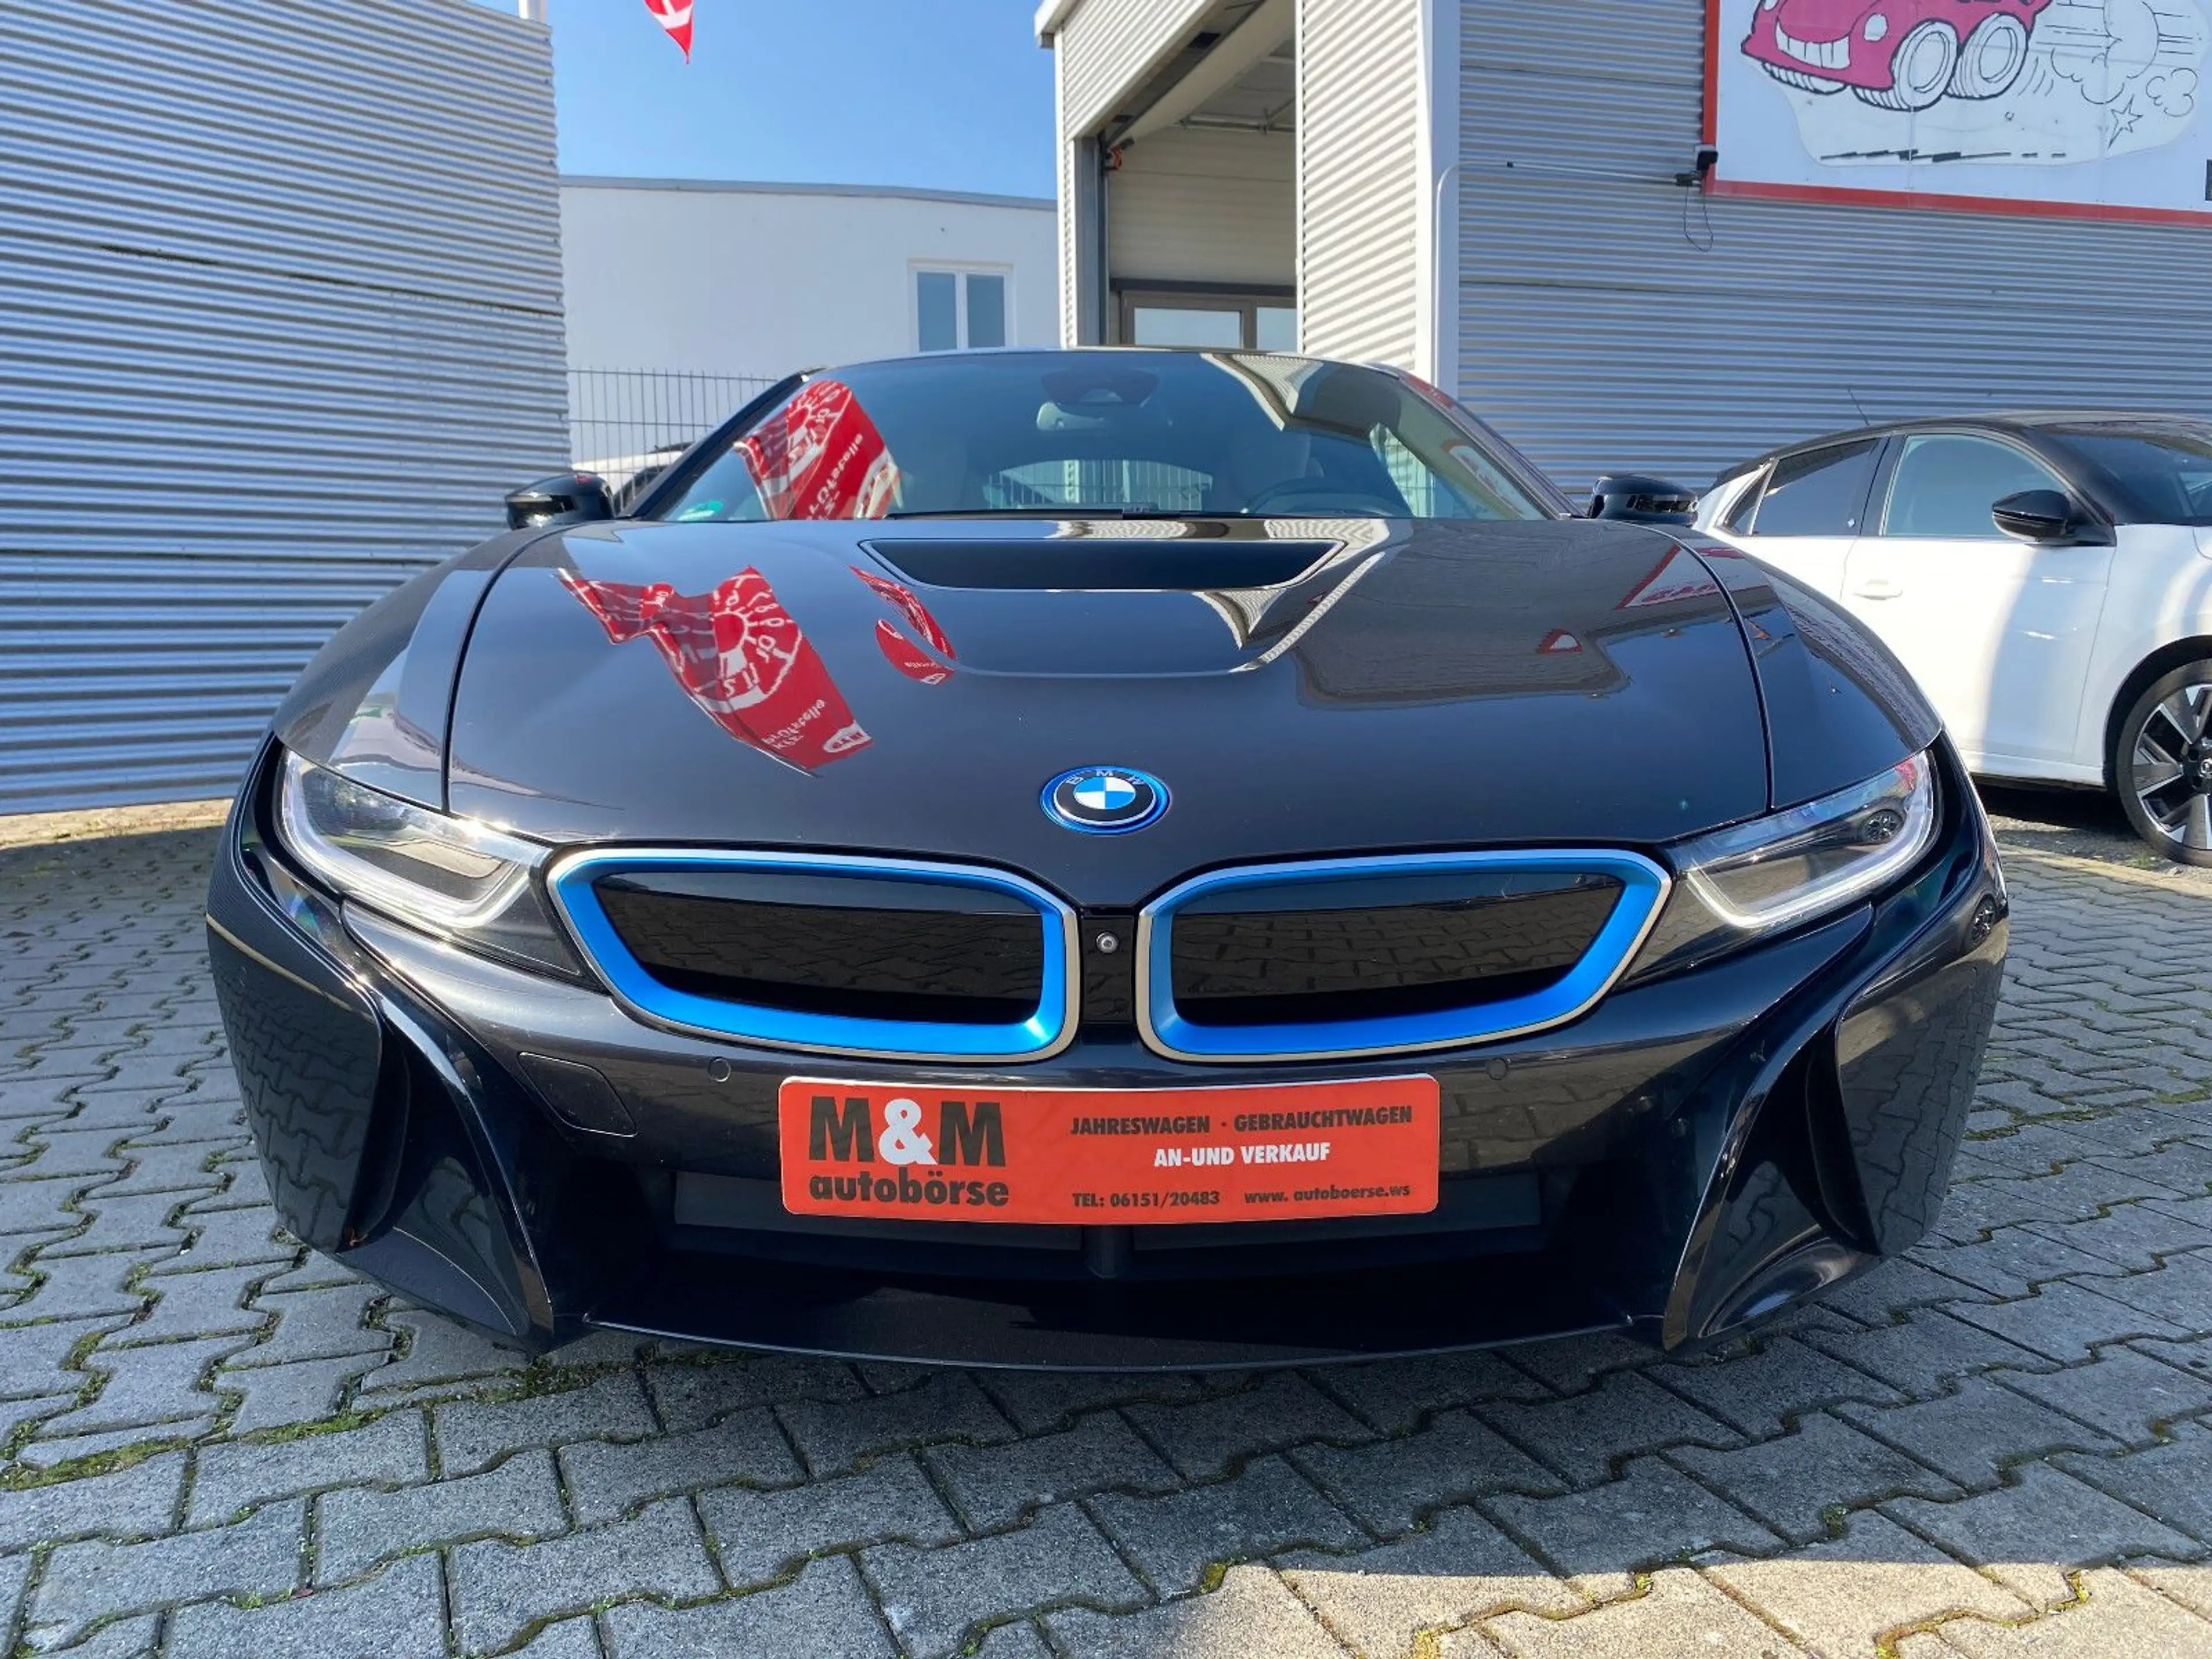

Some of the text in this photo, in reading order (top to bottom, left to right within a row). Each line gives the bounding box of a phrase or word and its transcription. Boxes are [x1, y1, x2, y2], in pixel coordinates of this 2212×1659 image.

[1065, 769, 1145, 785] BMW
[809, 1096, 1006, 1167] M&M
[1070, 1105, 1412, 1135] JAHRESWAGEN GEBRAUCHTWAGEN
[1154, 1142, 1331, 1167] AN-UND VERKAUF
[809, 1166, 1009, 1206] autobörse
[1072, 1191, 1221, 1209] TEL: 06151/20483
